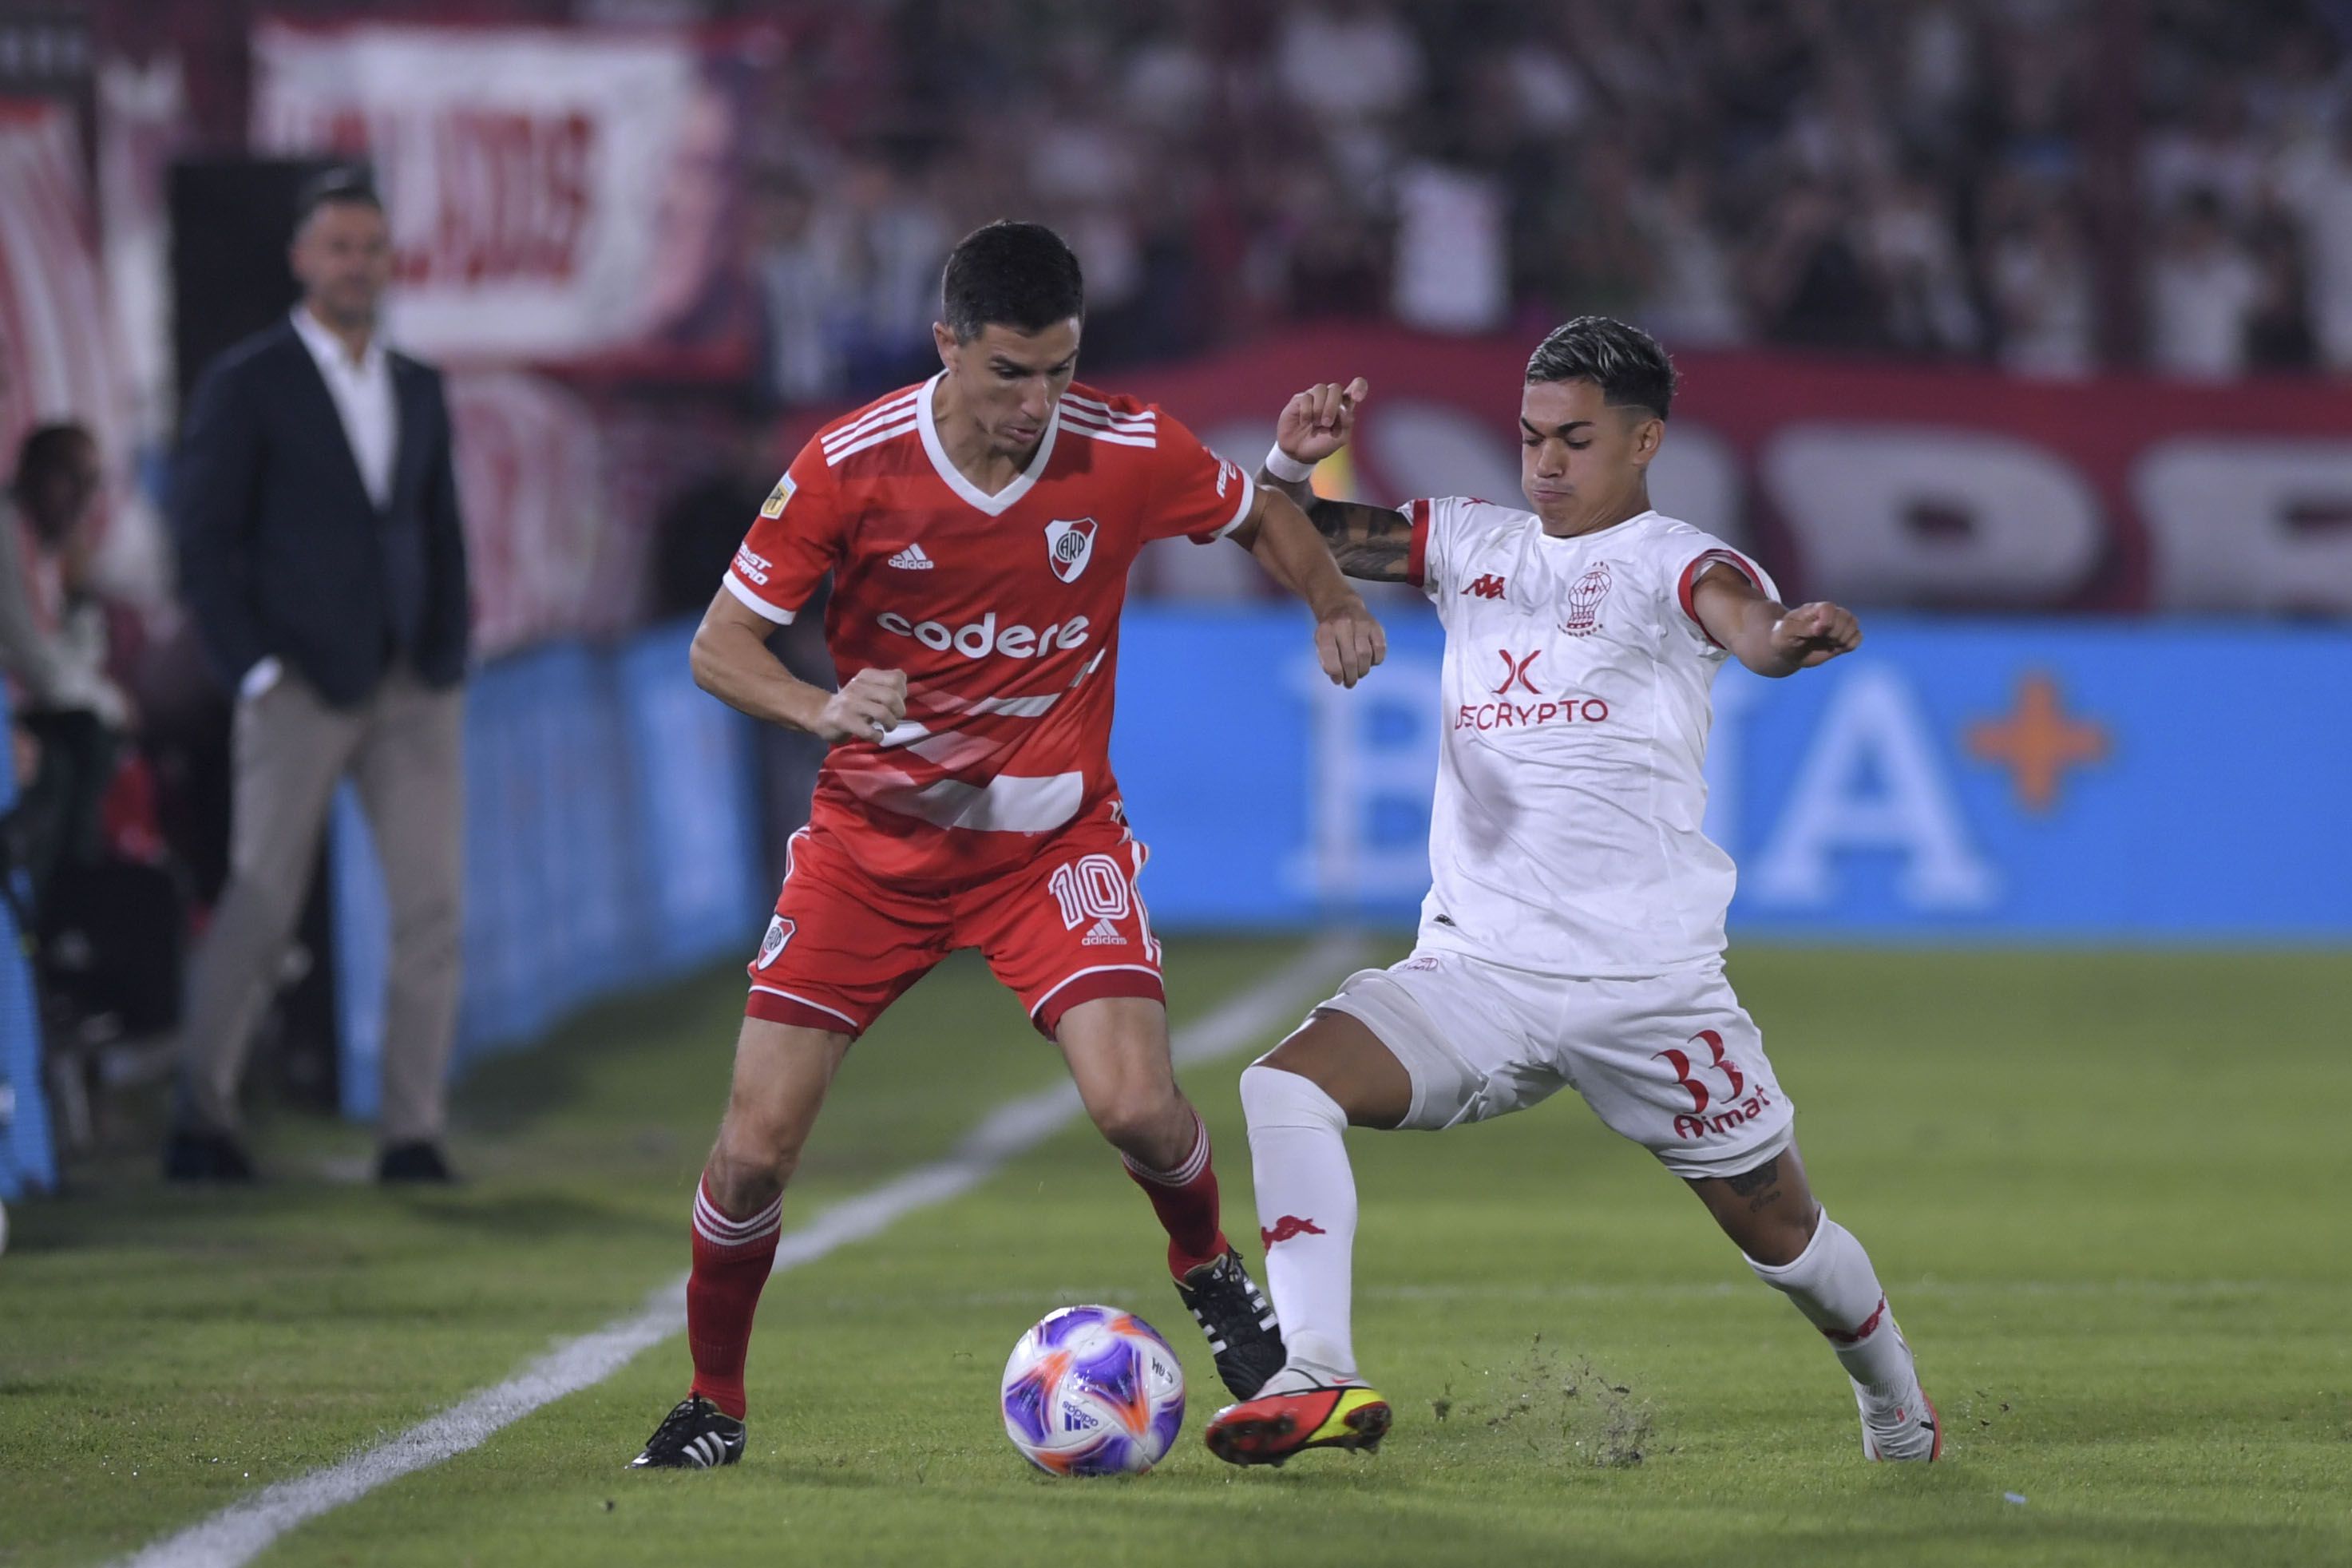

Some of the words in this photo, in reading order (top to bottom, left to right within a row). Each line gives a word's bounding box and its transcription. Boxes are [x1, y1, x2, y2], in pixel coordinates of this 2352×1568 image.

[888, 558, 934, 570] adidas
[877, 612, 1090, 659] codere
[1047, 853, 1130, 932] 10
[1081, 936, 1128, 946] adidas
[1650, 1029, 1744, 1115] 33
[1062, 1400, 1099, 1427] adidas
